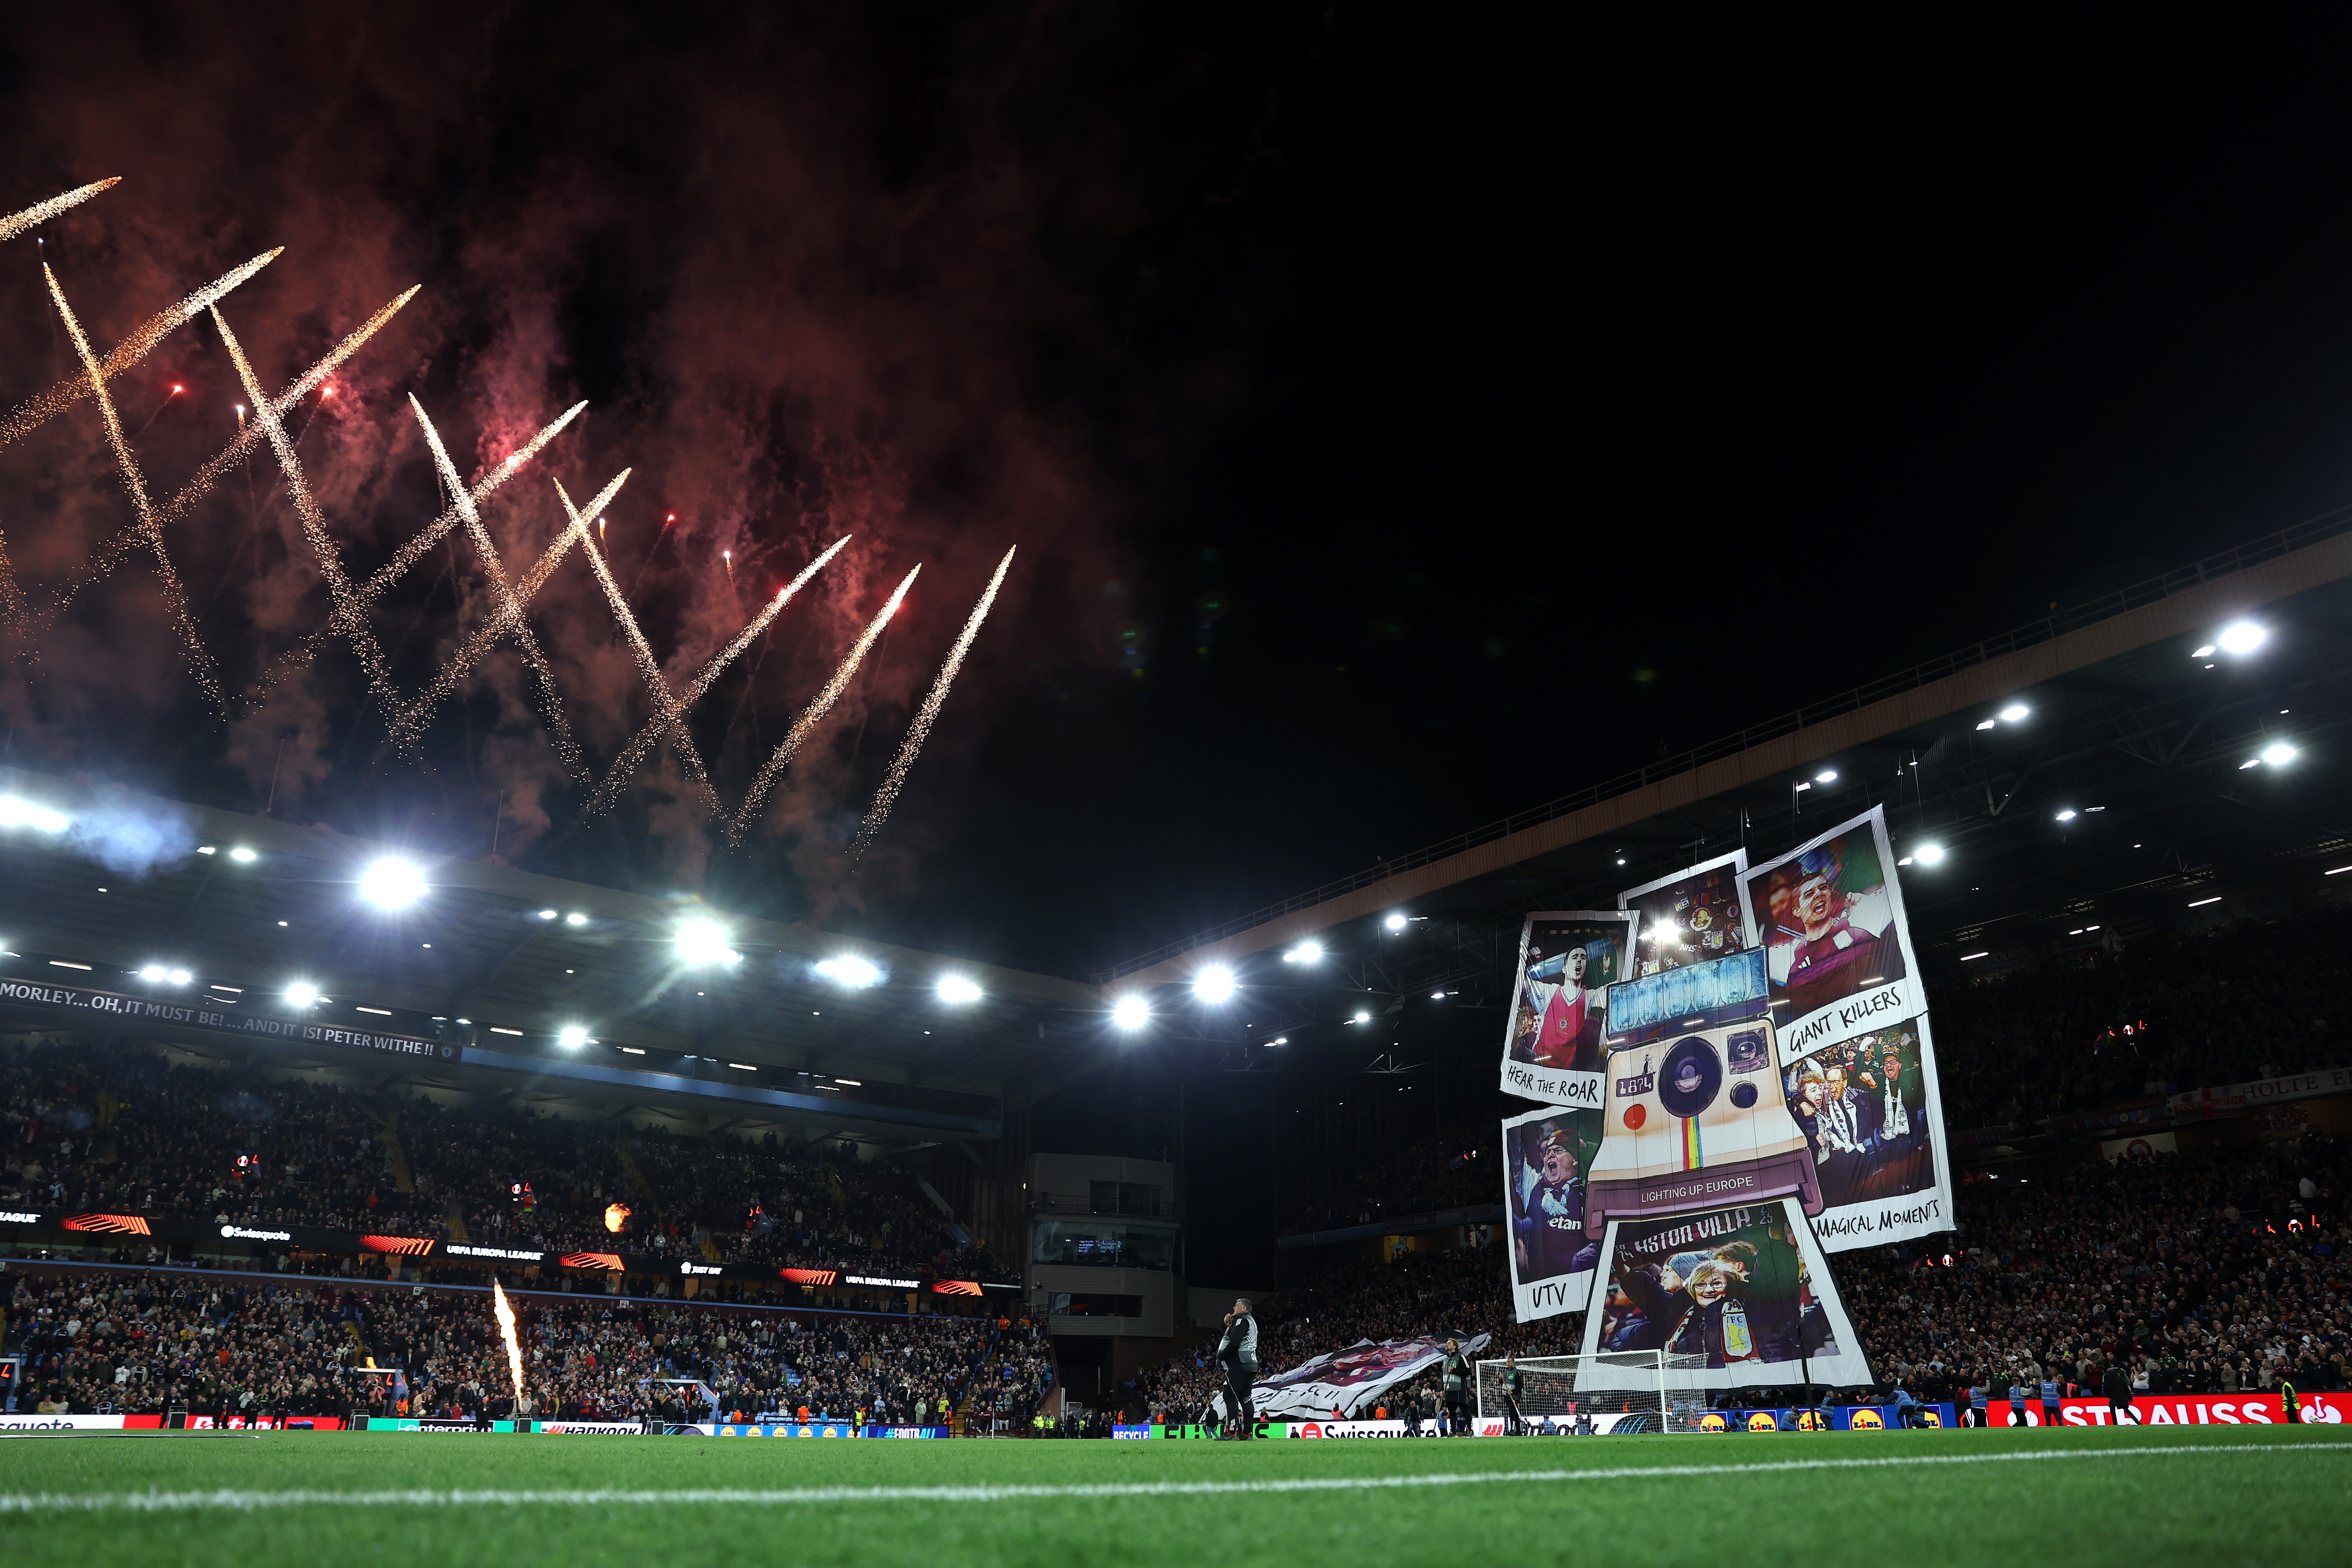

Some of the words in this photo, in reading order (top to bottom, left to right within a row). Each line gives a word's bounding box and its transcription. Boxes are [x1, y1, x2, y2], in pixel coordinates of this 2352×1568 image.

[1679, 943, 1696, 952] NHS
[91, 996, 122, 1014] OH,
[125, 1001, 143, 1014] IT
[145, 1004, 194, 1022] MUST
[199, 1012, 224, 1026] BE!
[244, 1018, 279, 1034] AND
[283, 1024, 297, 1036] IT
[302, 1026, 321, 1039] IS!
[325, 1029, 371, 1047] PETER
[374, 1036, 422, 1054] WITHE
[1790, 1012, 1832, 1052] GIANT
[1839, 987, 1901, 1028] KILLERS
[1507, 1065, 1533, 1090] HEAR
[1537, 1080, 1555, 1093] THE
[1558, 1079, 1598, 1103] ROAR
[1620, 1077, 1651, 1094] 1874
[2243, 1075, 2319, 1100] HOLTE
[2177, 1097, 2240, 1112] POLESWORTH
[1641, 1187, 1686, 1203] LIGHTING
[1689, 1184, 1704, 1196] UP
[1706, 1176, 1754, 1193] EUROPE
[1547, 1216, 1582, 1230] etan
[1696, 1208, 1752, 1239] VILLA
[1817, 1215, 1874, 1238] MAGICAL
[1879, 1199, 1939, 1231] MOMENTS
[234, 1227, 291, 1241] Swissquote
[447, 1245, 471, 1256] UEFA
[472, 1247, 507, 1258] EUROPA
[708, 1267, 722, 1275] EAT
[846, 1276, 865, 1284] UEFA
[865, 1277, 892, 1286] EUROPA
[1533, 1283, 1566, 1308] UTV
[2062, 1402, 2272, 1425] STRAUSS
[1113, 1431, 1149, 1439] RECYCLE
